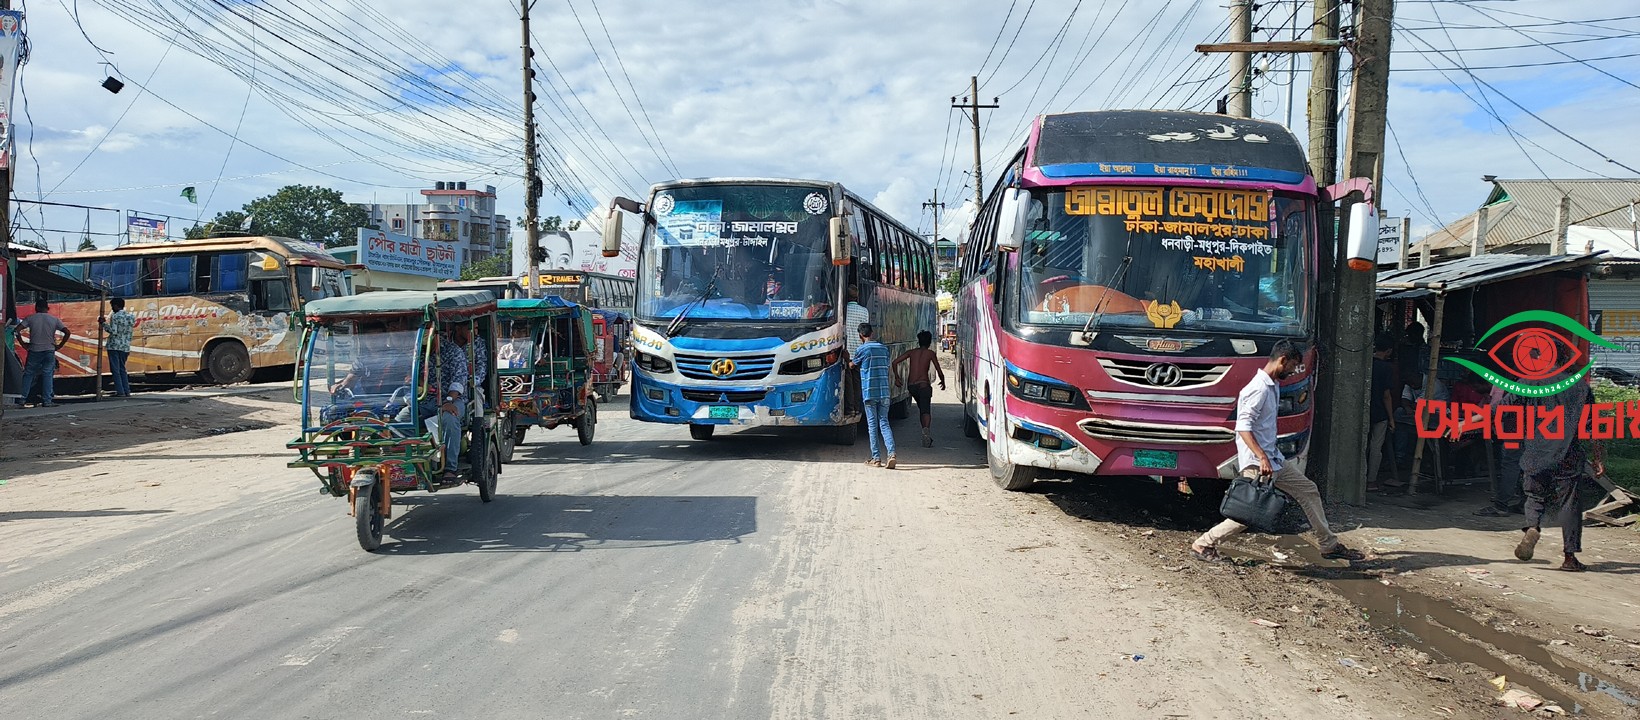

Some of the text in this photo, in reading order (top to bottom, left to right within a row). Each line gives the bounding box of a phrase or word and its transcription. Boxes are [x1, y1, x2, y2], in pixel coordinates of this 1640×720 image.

[1065, 187, 1165, 220] জান্নাতুল
[1124, 219, 1269, 240] ঢাকা-জামালপুর-ঢাকা
[368, 231, 396, 253] পৌর
[399, 237, 422, 257] যাত্রী
[1161, 235, 1274, 256] ধনবাড়ী-মধুপুর-দিকপাইত
[1193, 255, 1245, 273] মহাখালী
[553, 275, 581, 284] TRAVELS
